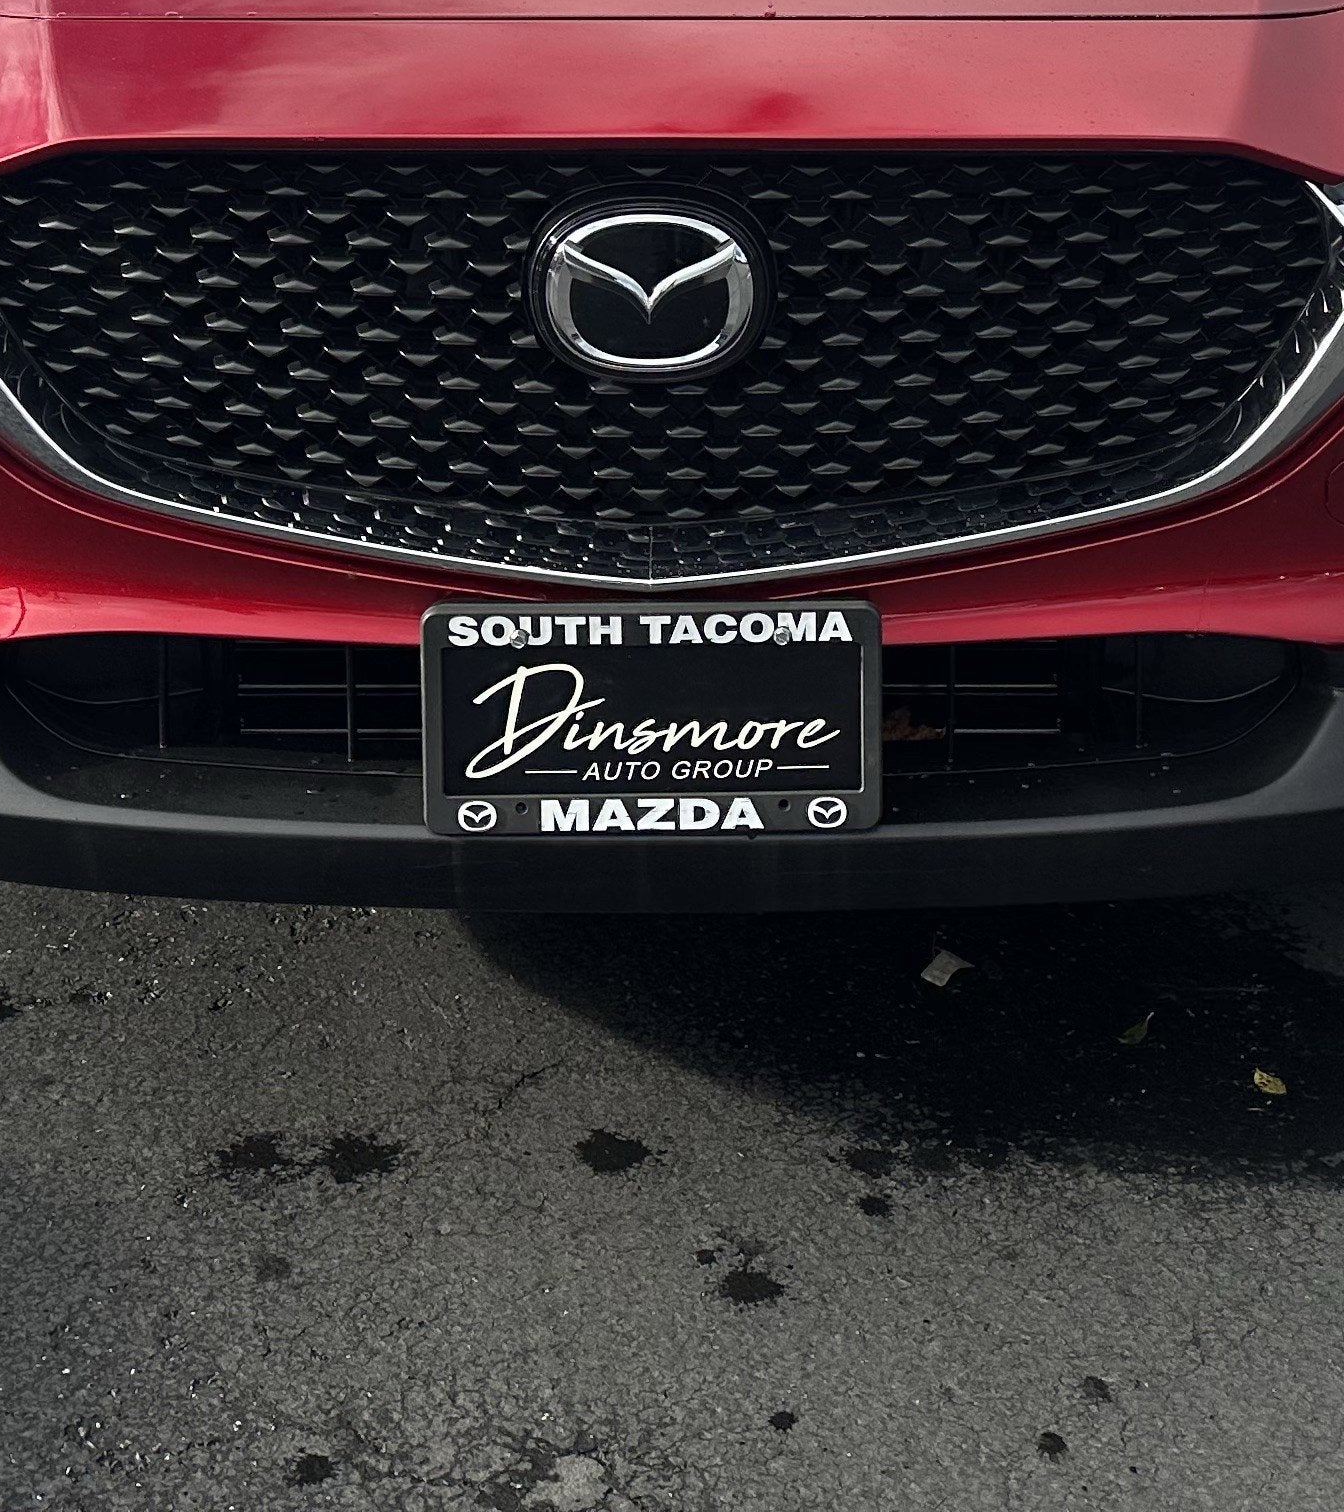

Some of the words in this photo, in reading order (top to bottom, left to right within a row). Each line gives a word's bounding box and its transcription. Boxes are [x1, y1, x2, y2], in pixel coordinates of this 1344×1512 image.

[448, 615, 623, 645] SOUTH
[640, 611, 853, 645] TACOMA
[465, 663, 841, 779] Dinsmore
[582, 760, 661, 781] AUTO
[671, 759, 774, 780] GROUP
[541, 797, 765, 832] MAZDA
